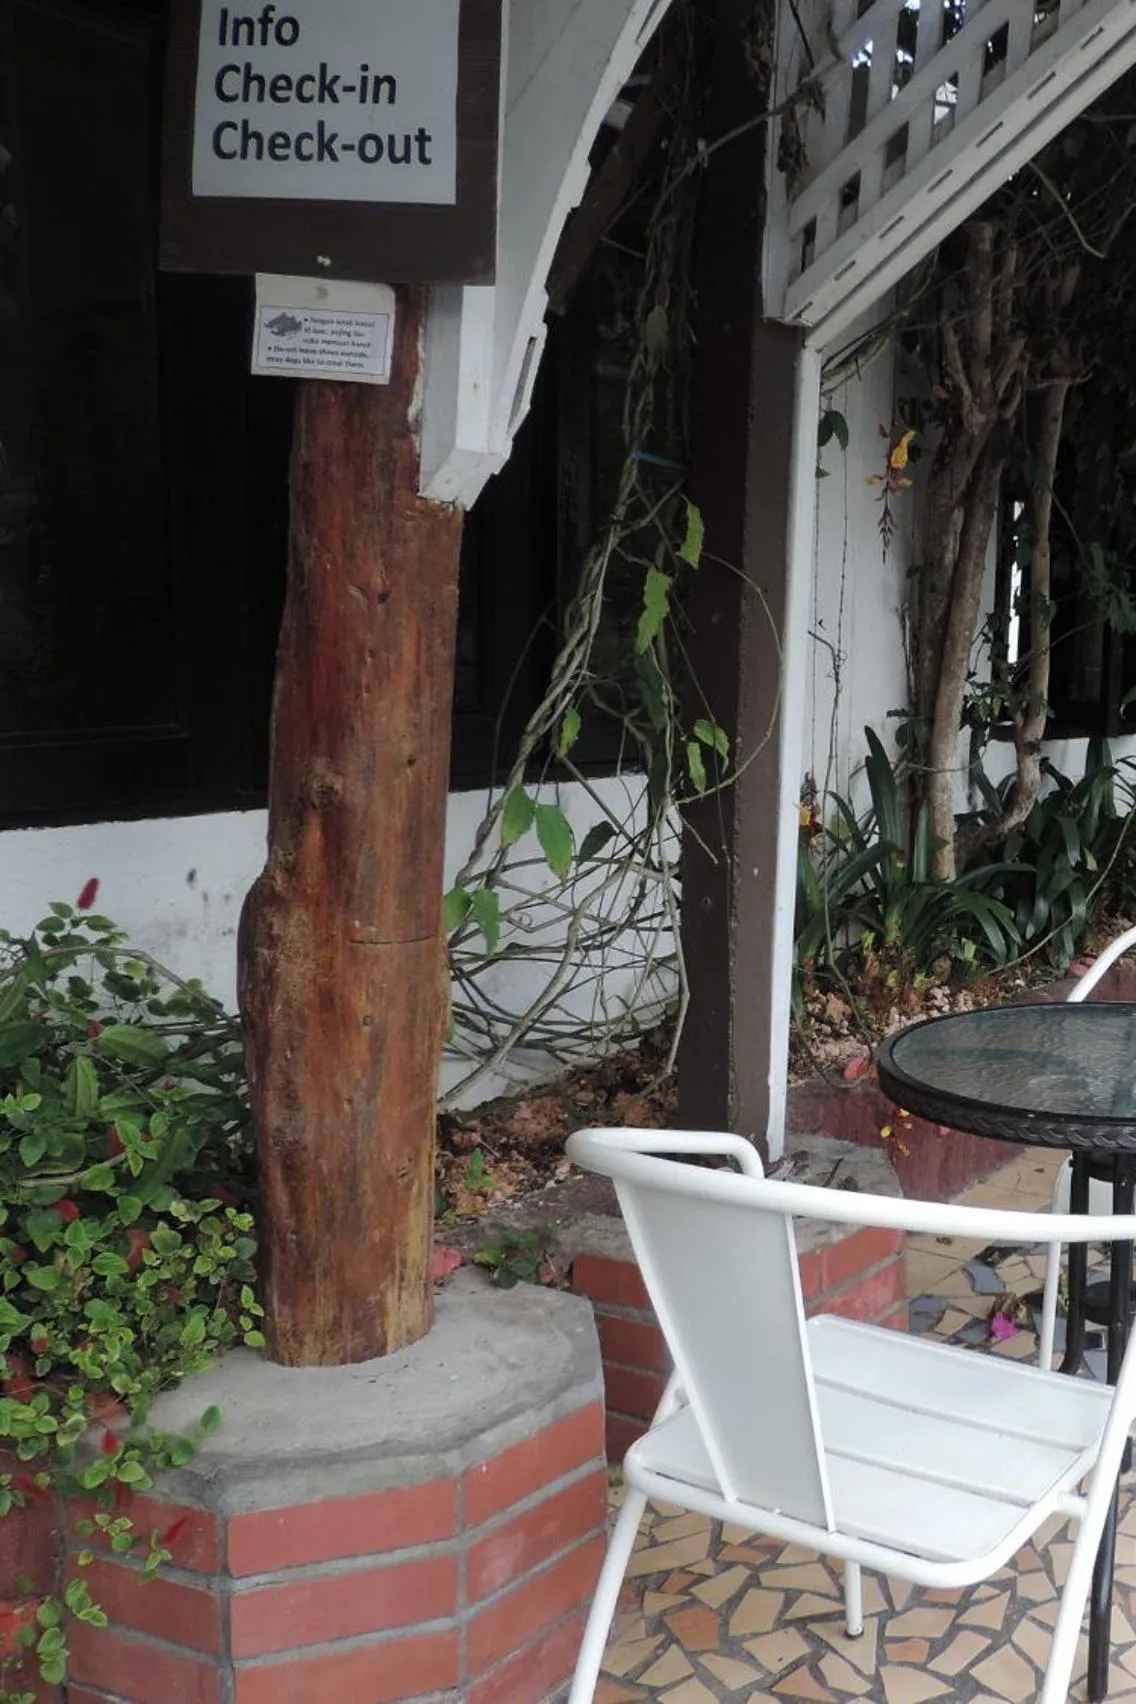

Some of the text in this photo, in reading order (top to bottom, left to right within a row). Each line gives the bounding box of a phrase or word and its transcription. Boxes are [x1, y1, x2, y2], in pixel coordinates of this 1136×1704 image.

[218, 4, 301, 47] Info
[214, 62, 397, 105] Check-in
[212, 119, 433, 166] Check-out
